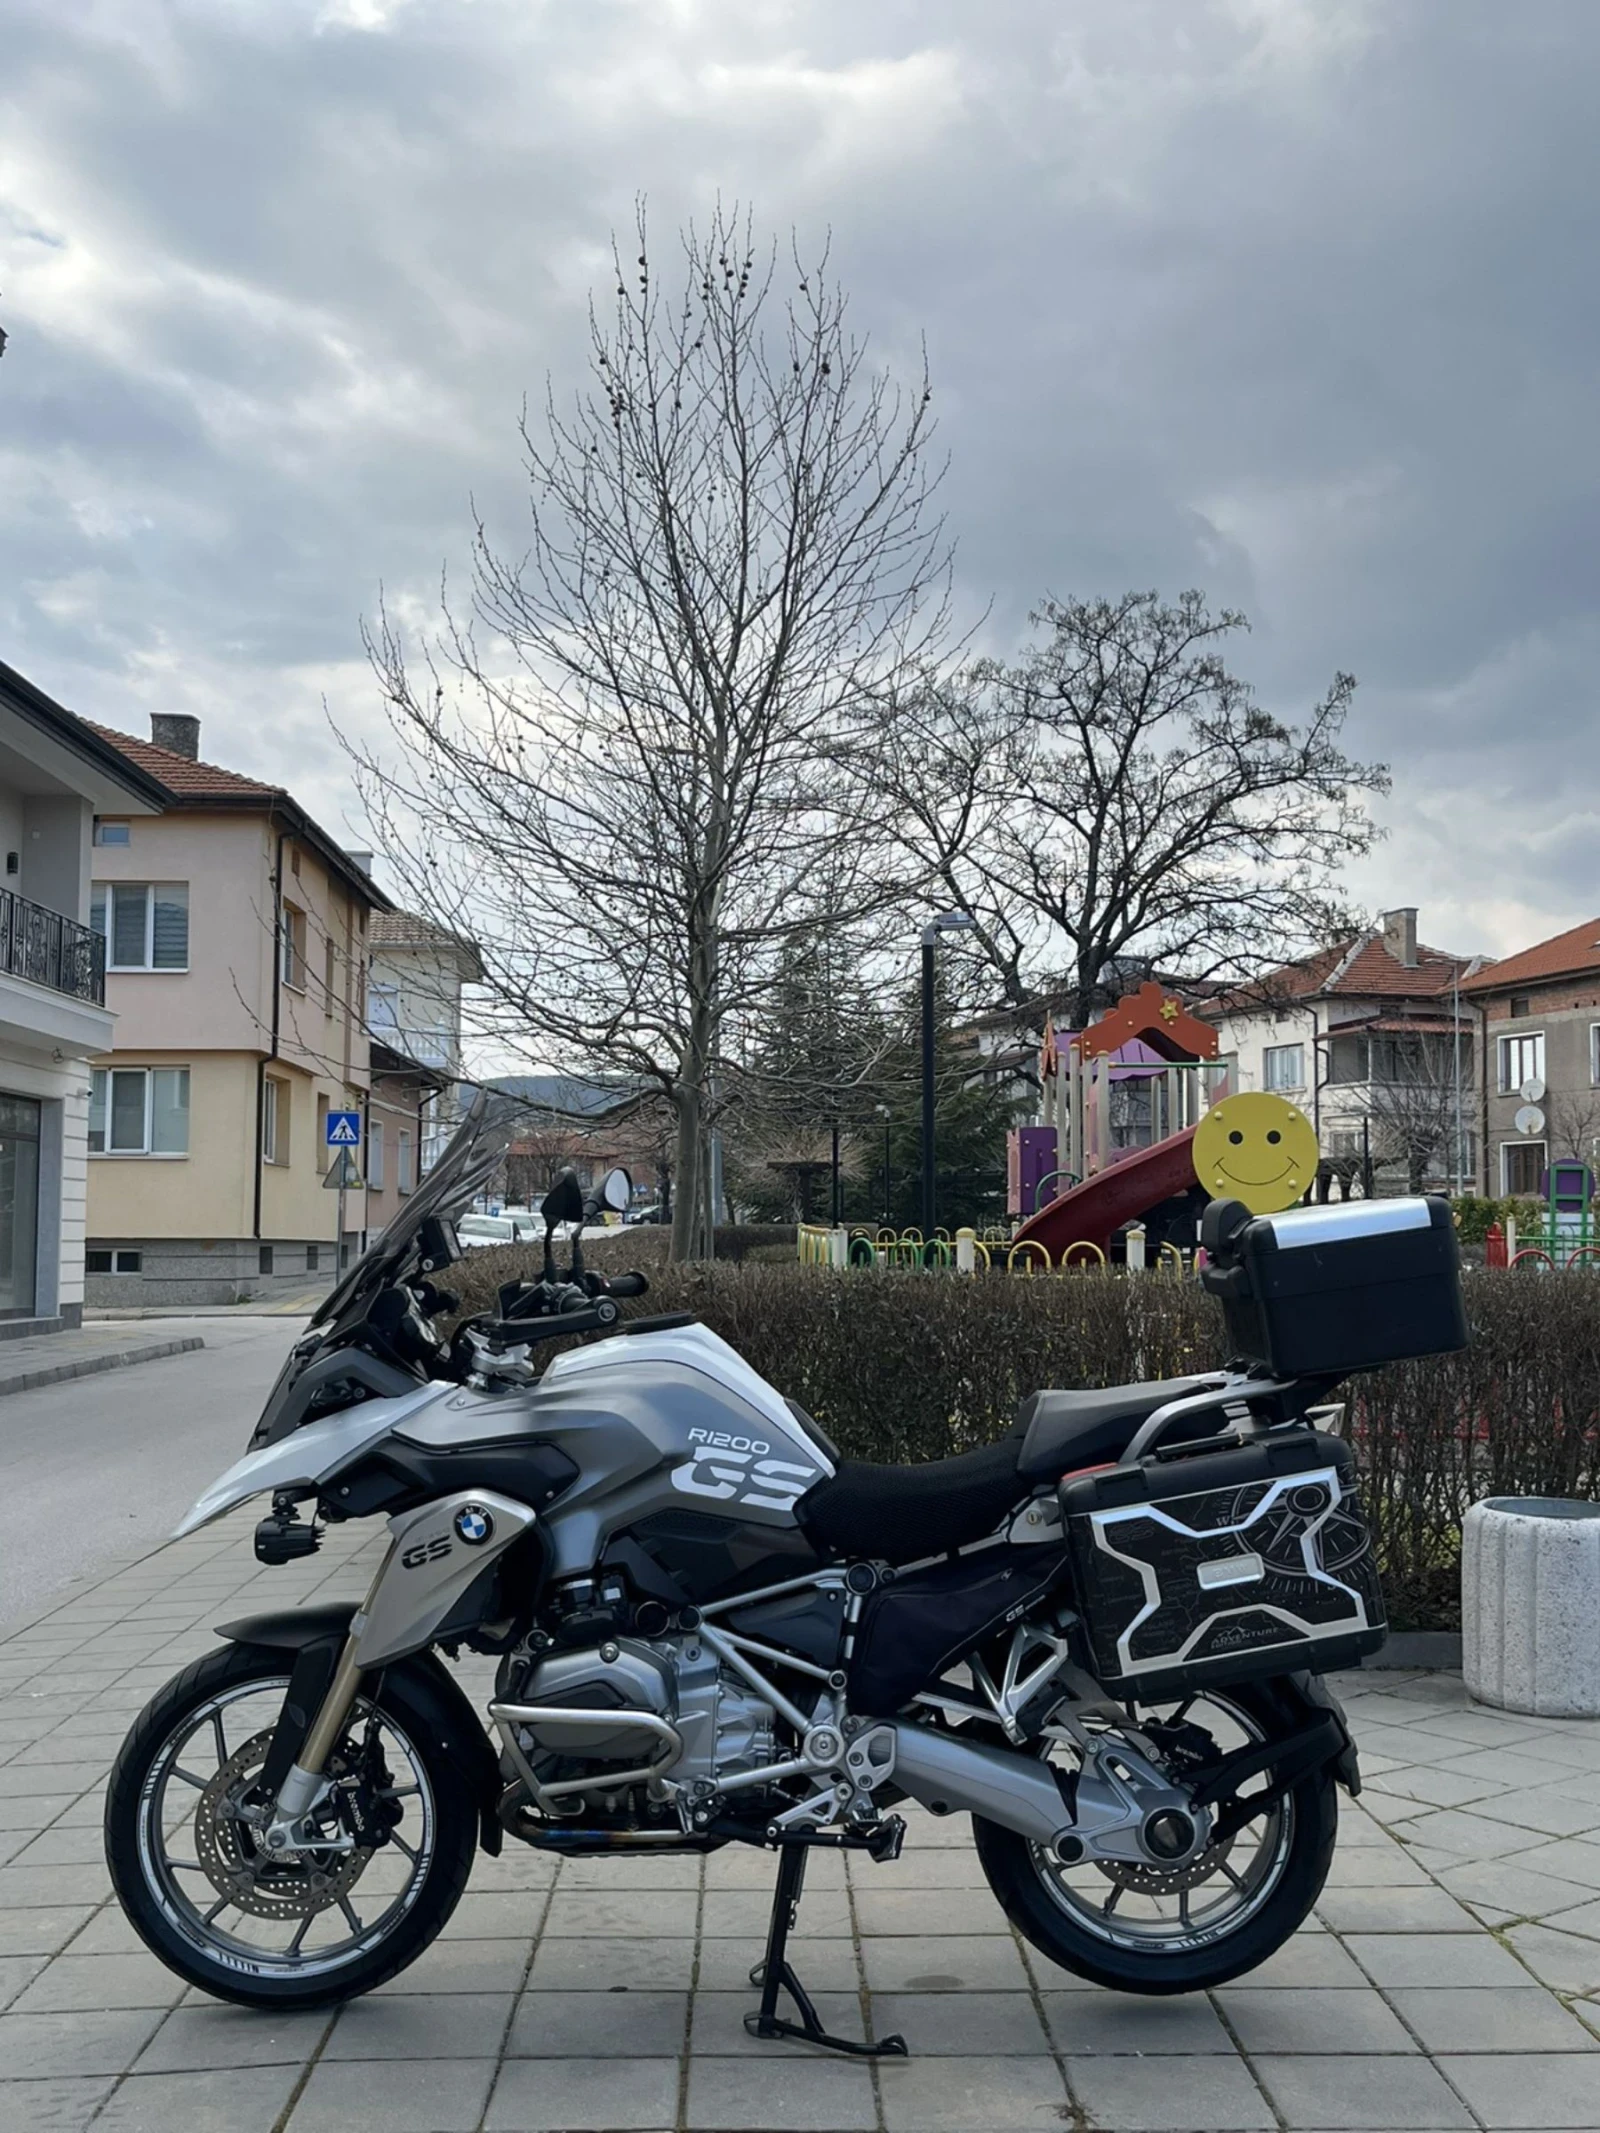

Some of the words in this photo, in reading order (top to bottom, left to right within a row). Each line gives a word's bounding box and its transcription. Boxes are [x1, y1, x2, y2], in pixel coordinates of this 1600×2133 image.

[688, 1427, 770, 1455] R1200
[671, 1446, 816, 1511] GS
[401, 1534, 453, 1570] GS
[347, 1791, 365, 1832] brembo
